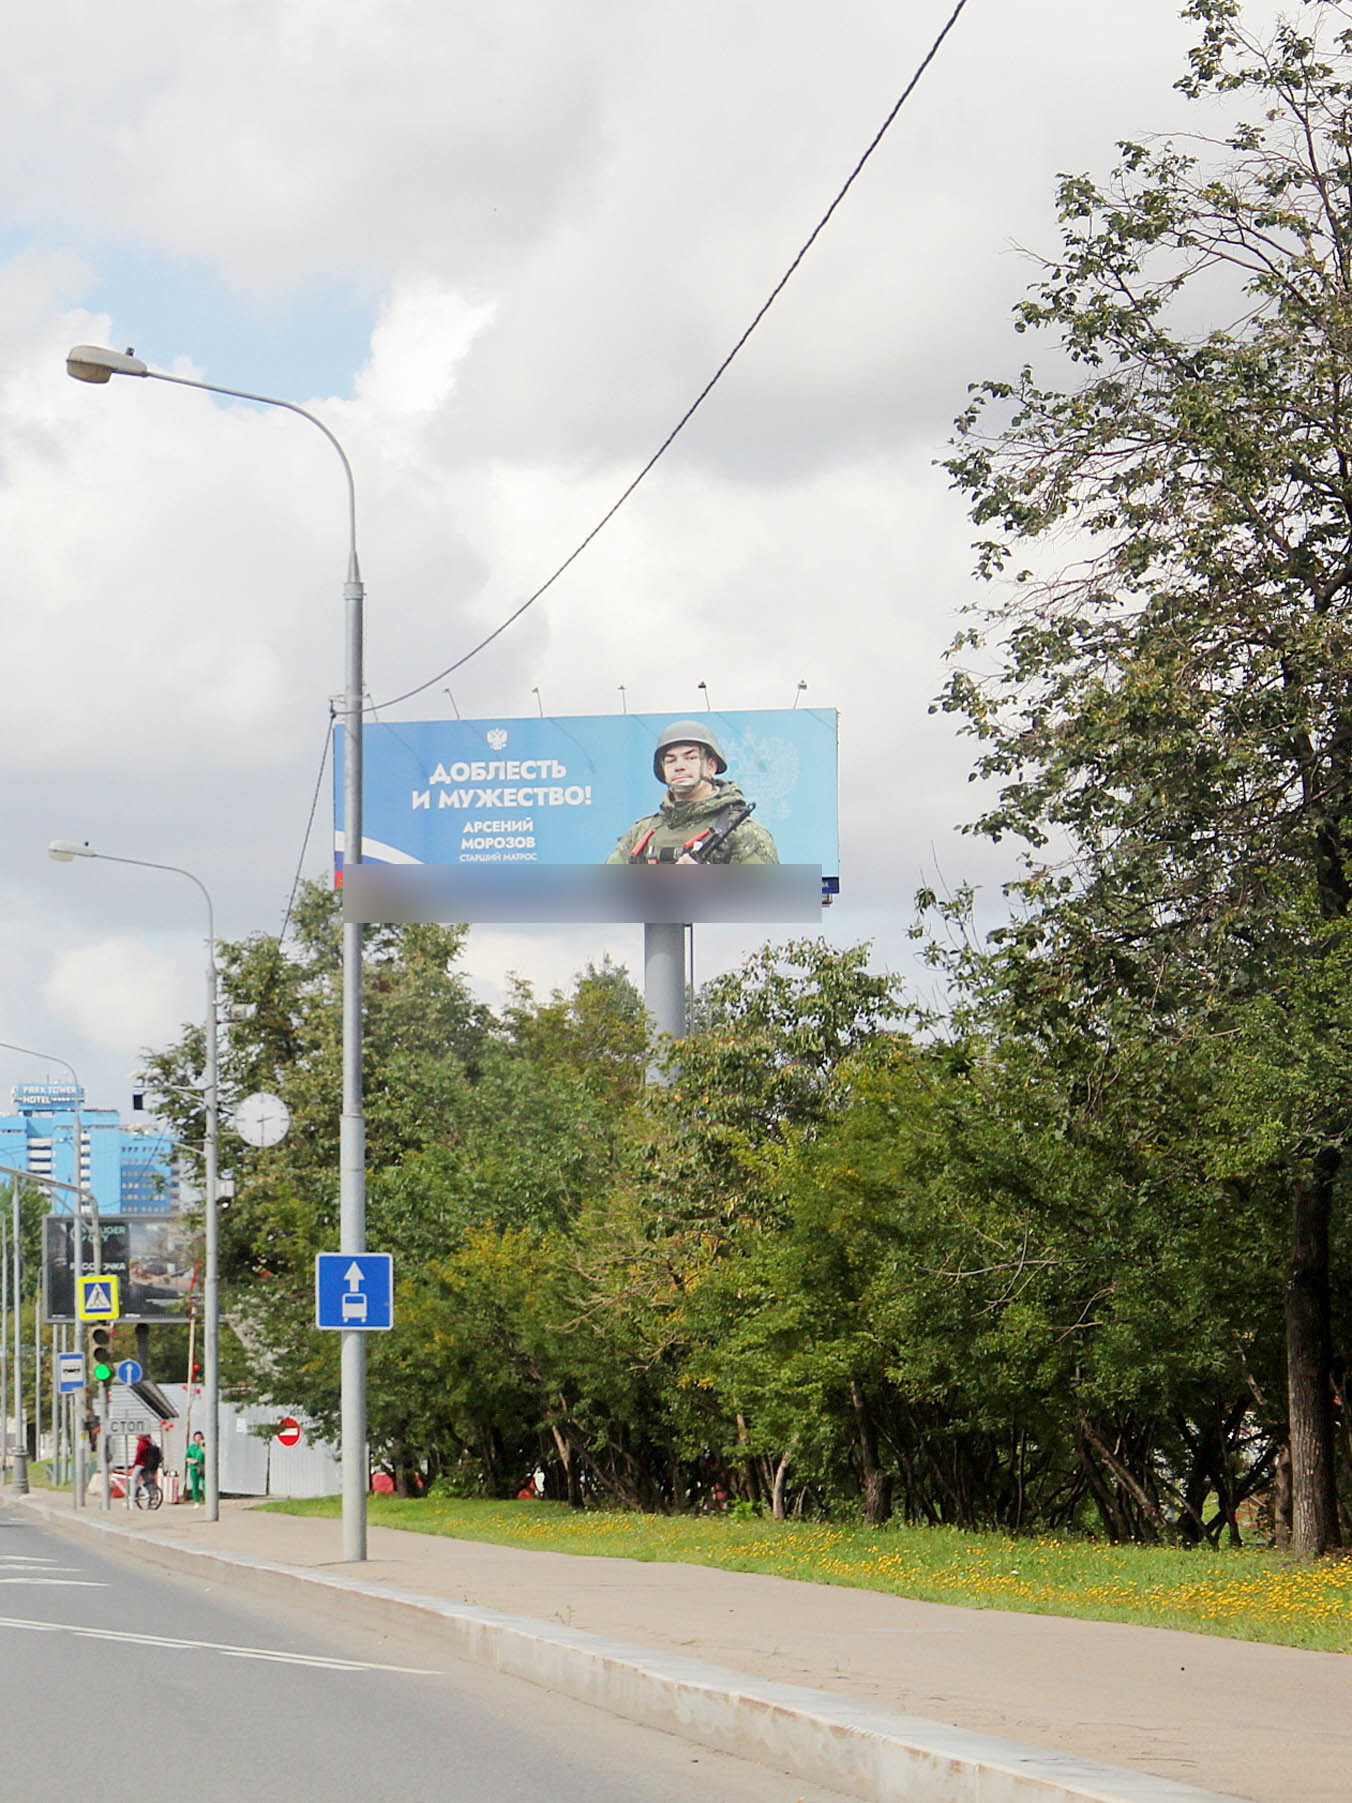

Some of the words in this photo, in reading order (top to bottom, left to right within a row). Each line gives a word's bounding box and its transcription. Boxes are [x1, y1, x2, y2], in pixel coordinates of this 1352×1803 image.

[429, 760, 567, 784] ДОБЛЕСТЬ
[412, 790, 430, 810] И
[438, 785, 592, 808] МУЖЕСТВО!
[463, 817, 534, 833] АРСЕНИЙ
[461, 837, 536, 850] МОРОЗОВ
[459, 852, 502, 863] СТАРШИЙ
[503, 852, 537, 862] МАТРОС
[111, 1421, 144, 1432] СТОП
